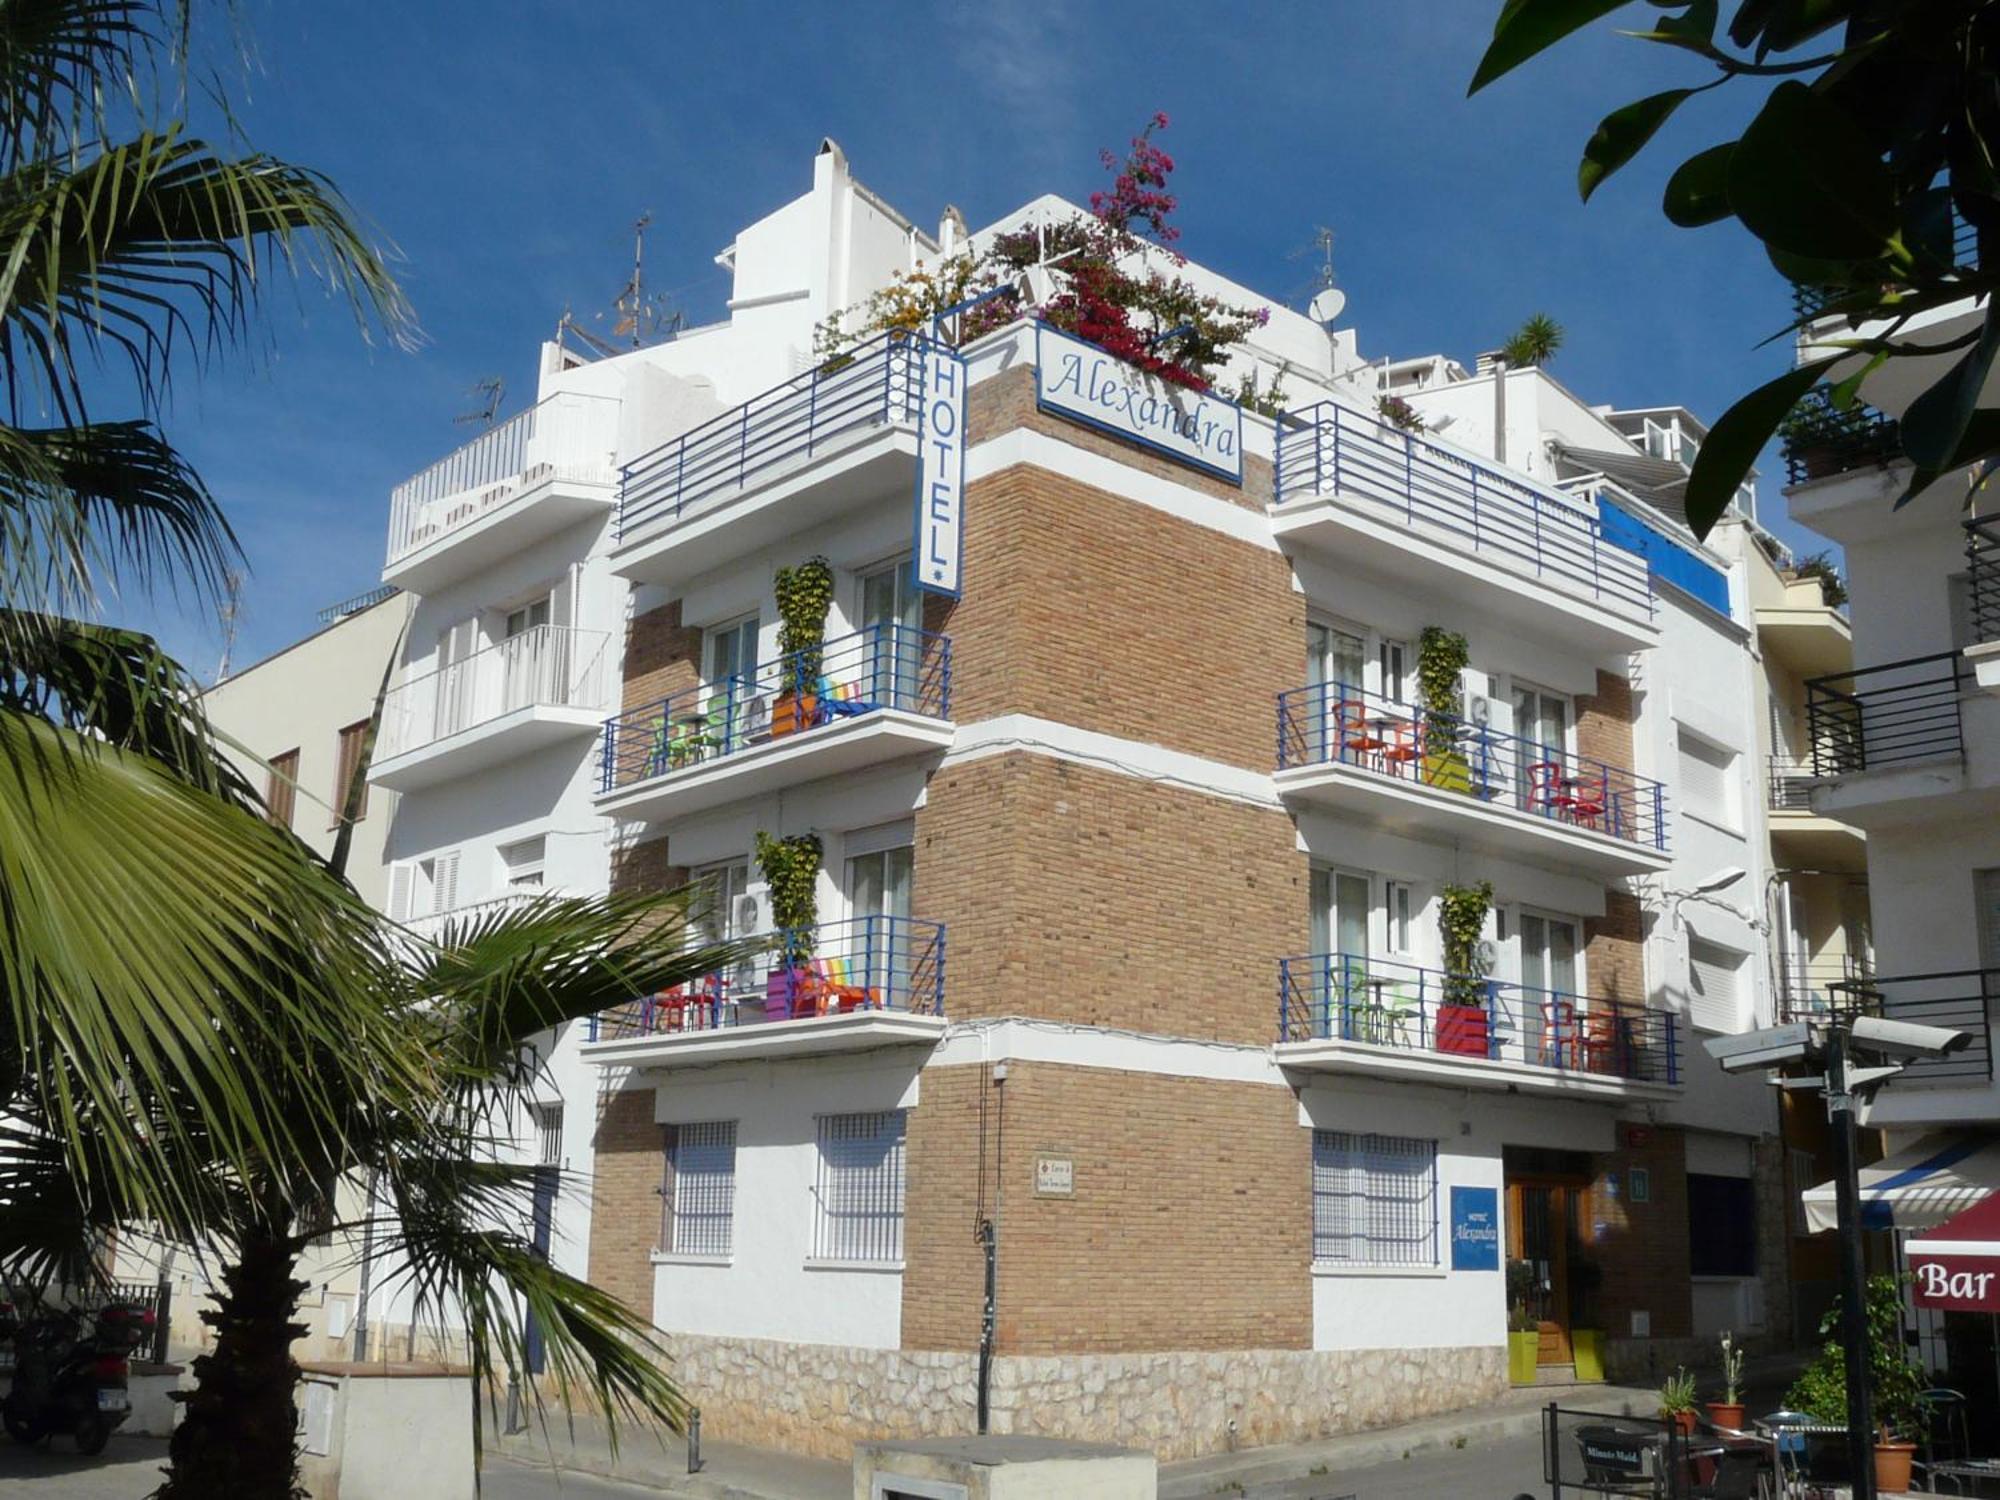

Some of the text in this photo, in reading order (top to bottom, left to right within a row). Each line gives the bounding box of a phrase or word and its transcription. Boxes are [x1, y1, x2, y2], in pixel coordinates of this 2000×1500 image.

[1047, 353, 1236, 457] Alexandra
[931, 357, 956, 567] HOTEL
[1917, 1262, 1995, 1300] Bar
